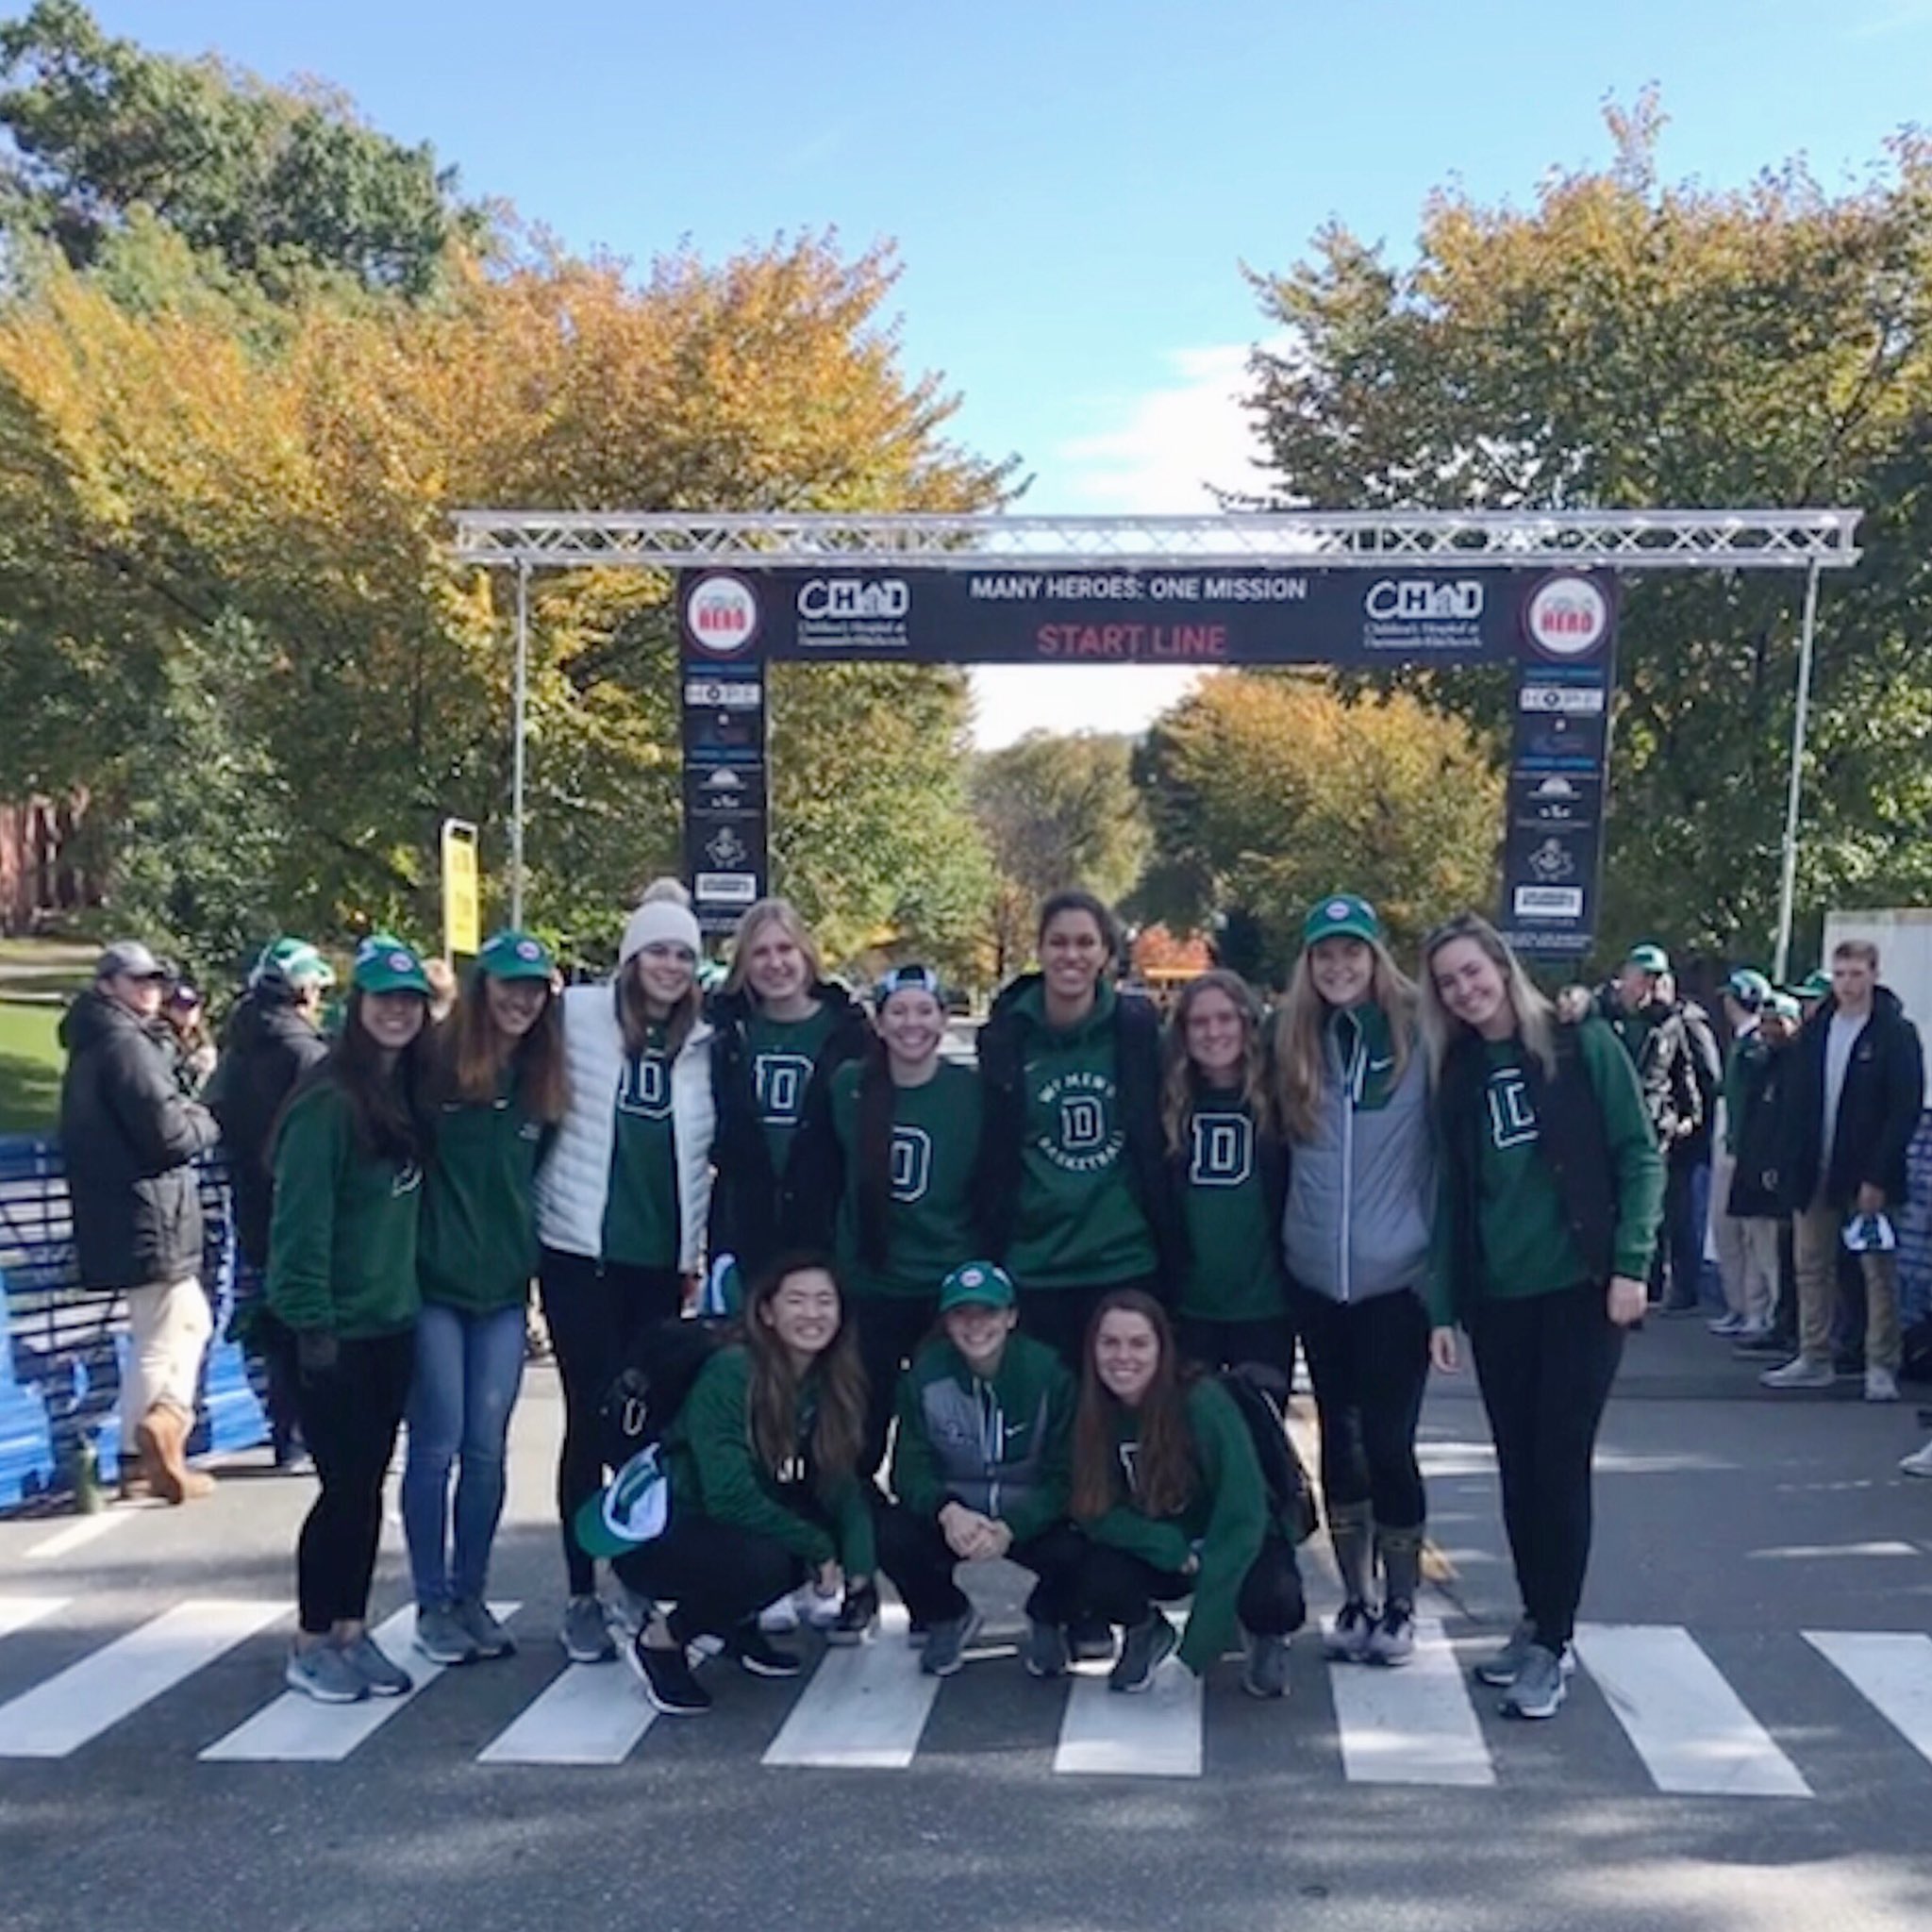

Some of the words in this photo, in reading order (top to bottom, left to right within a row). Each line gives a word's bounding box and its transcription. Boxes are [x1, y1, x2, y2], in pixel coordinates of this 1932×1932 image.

[970, 576, 1042, 599] MANY
[1045, 576, 1145, 600] HEROES:
[1150, 576, 1200, 600] ONE
[1204, 576, 1308, 601] MISSION
[1036, 622, 1145, 656] START
[1152, 623, 1227, 656] LINE
[1060, 1094, 1104, 1150] D
[1191, 1111, 1255, 1186] D
